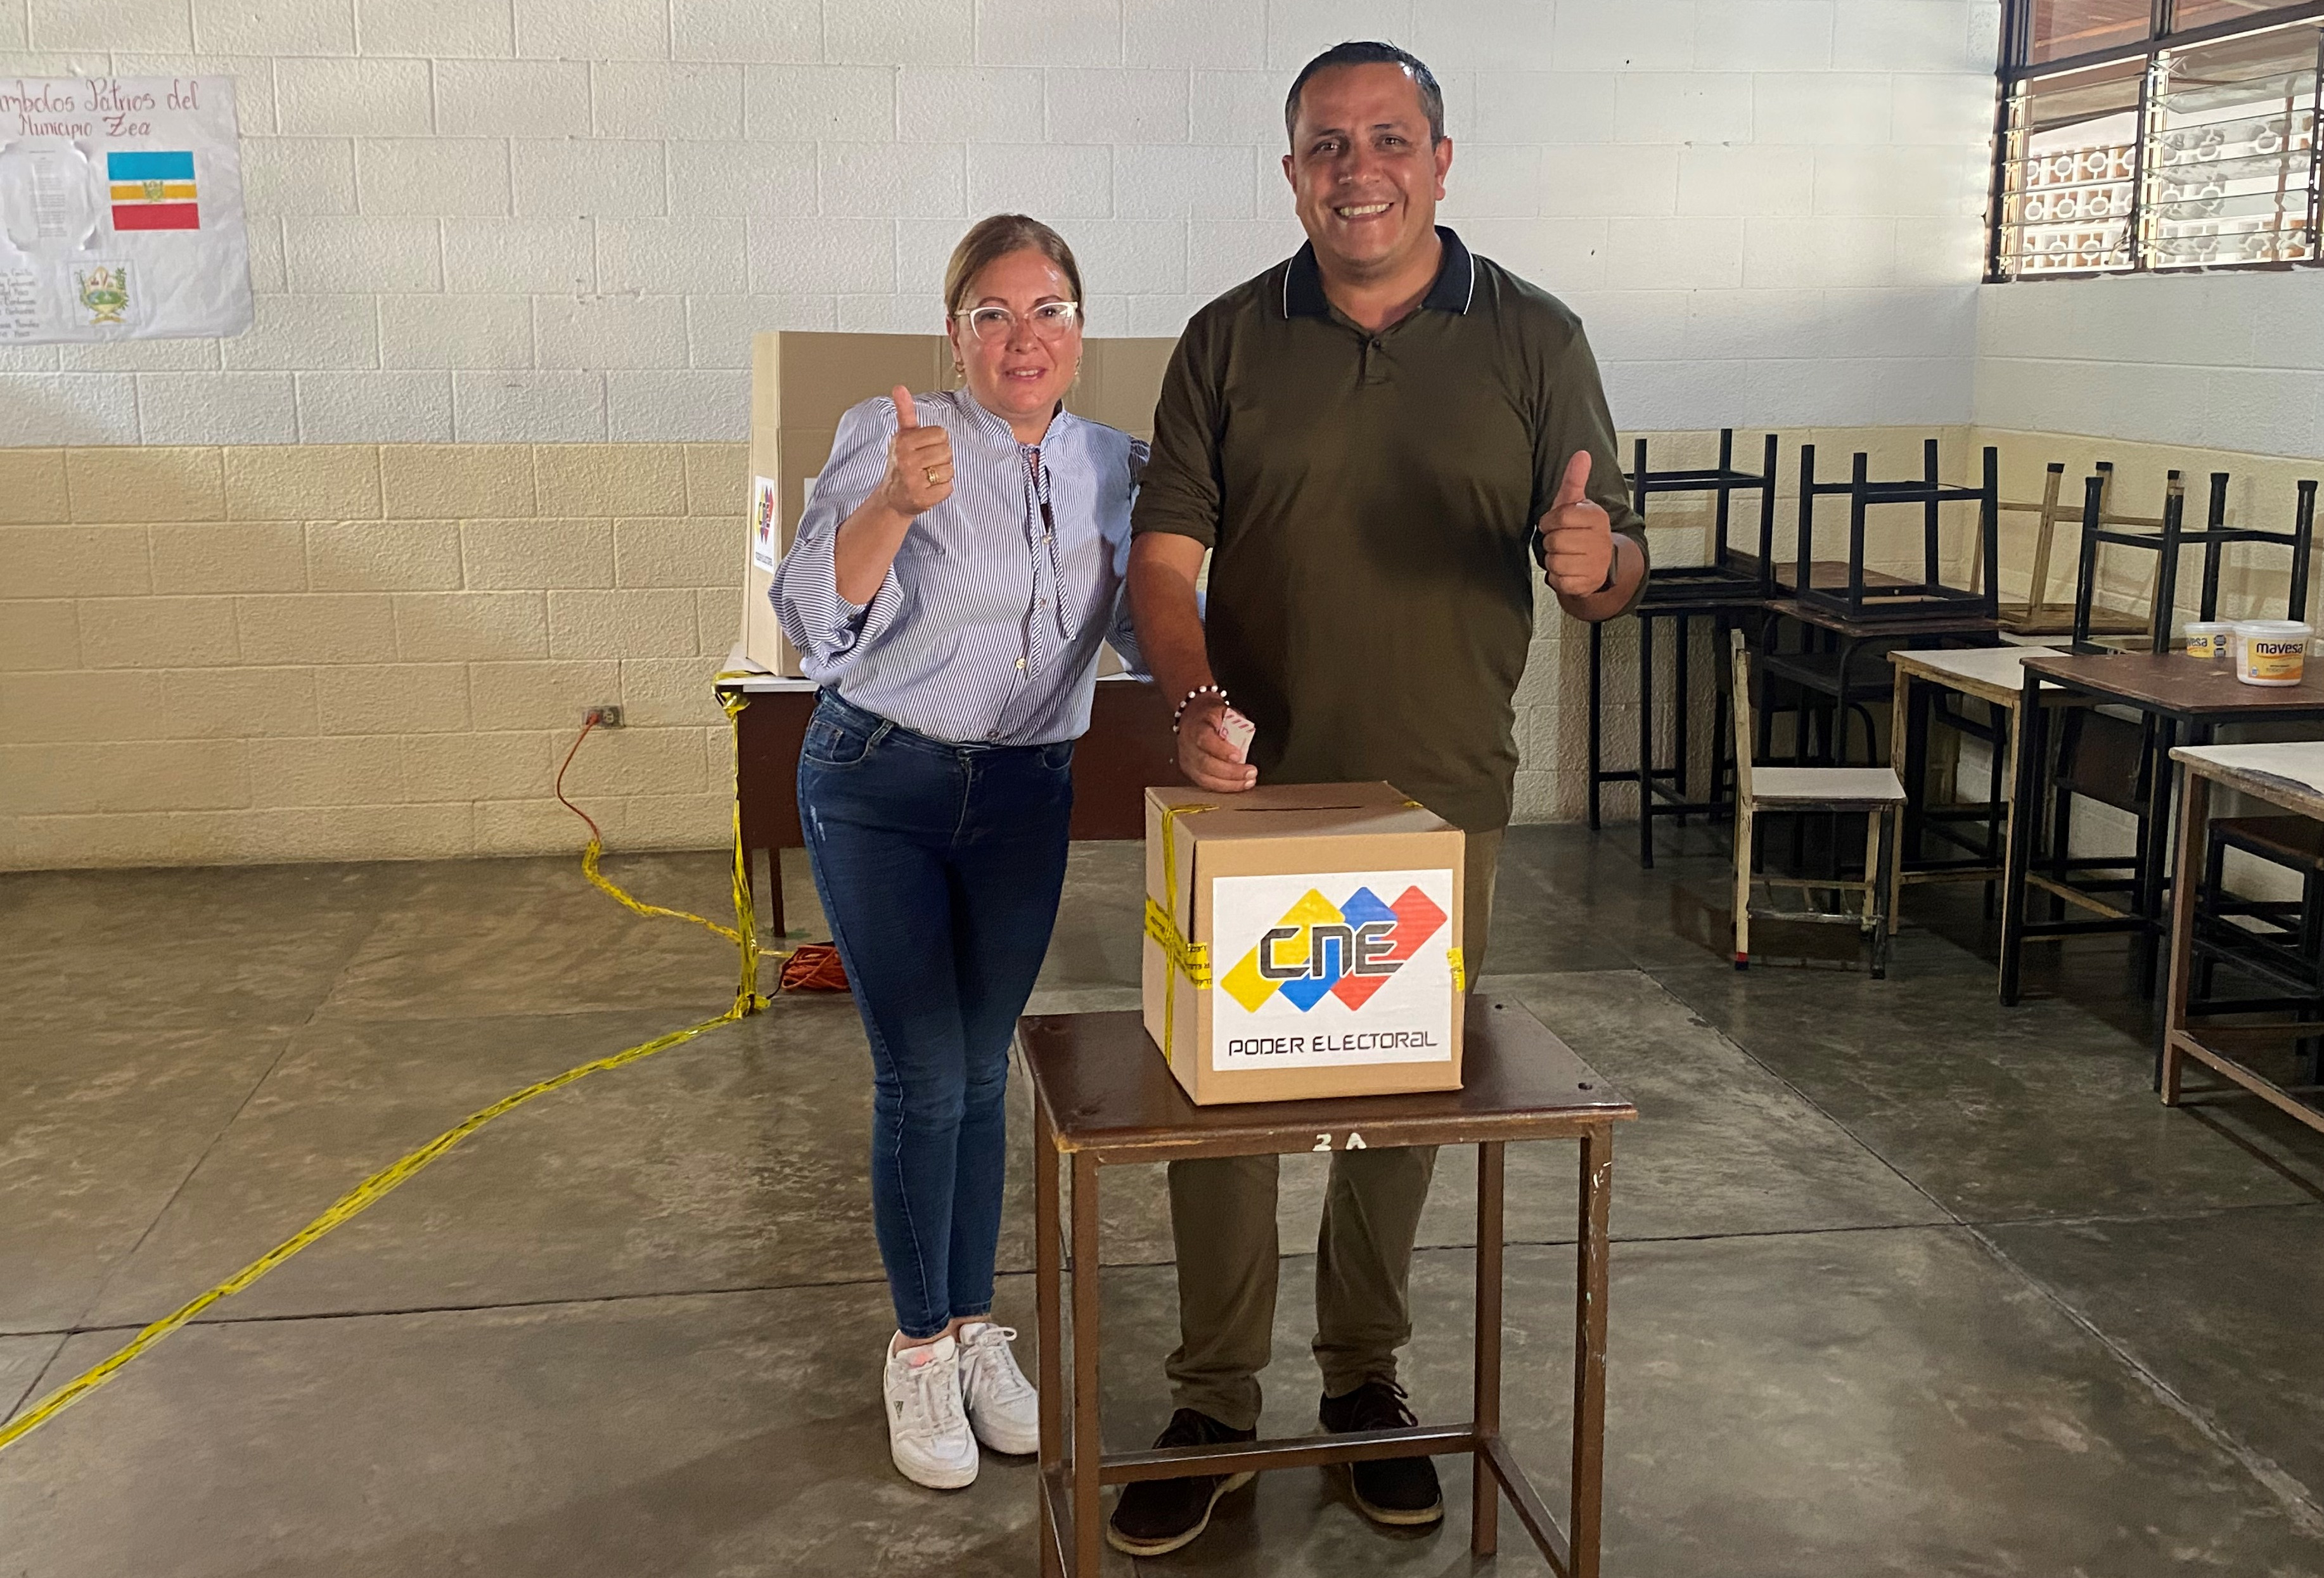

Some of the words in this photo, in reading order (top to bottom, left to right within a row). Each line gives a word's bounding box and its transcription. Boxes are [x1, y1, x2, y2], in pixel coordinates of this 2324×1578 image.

[84, 77, 156, 112] Patrios
[167, 79, 200, 111] del
[18, 112, 93, 139] Municipio
[102, 112, 151, 137] Zea
[2256, 642, 2304, 654] mavesa
[1260, 923, 1404, 979] CNE
[1228, 1037, 1304, 1056] PODER
[1312, 1030, 1439, 1052] ELECTORAL
[1312, 1132, 1332, 1152] 2
[1345, 1132, 1367, 1150] A
